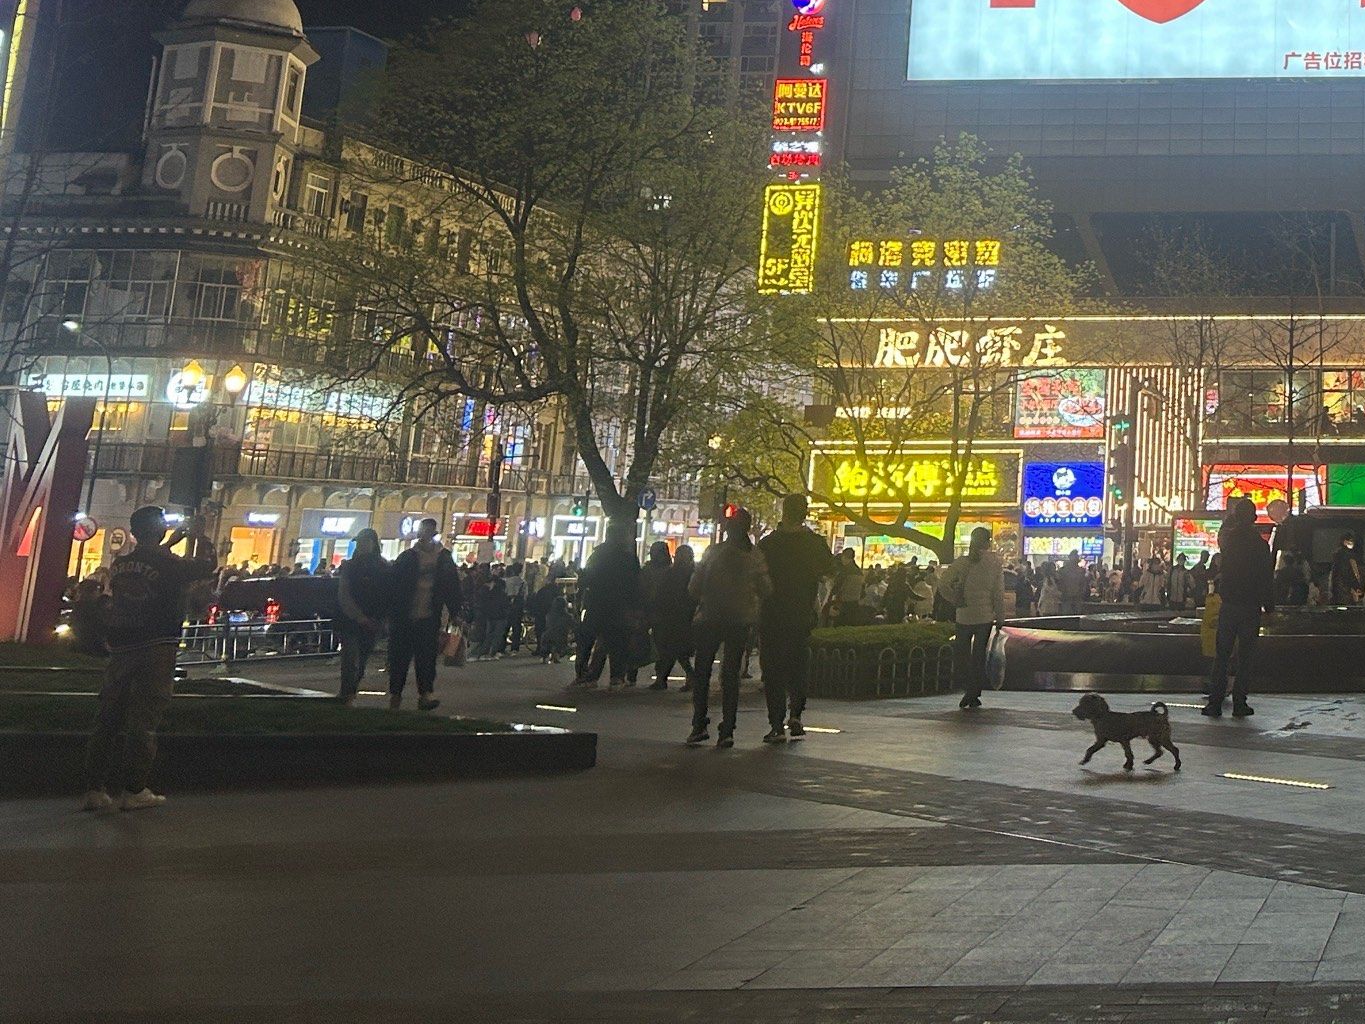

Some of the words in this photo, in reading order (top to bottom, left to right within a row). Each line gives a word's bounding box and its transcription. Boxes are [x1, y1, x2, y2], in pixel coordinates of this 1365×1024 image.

[778, 83, 823, 99] 阿曼达
[775, 102, 822, 114] KTV6F
[873, 324, 1068, 367] 肥肥虾庄
